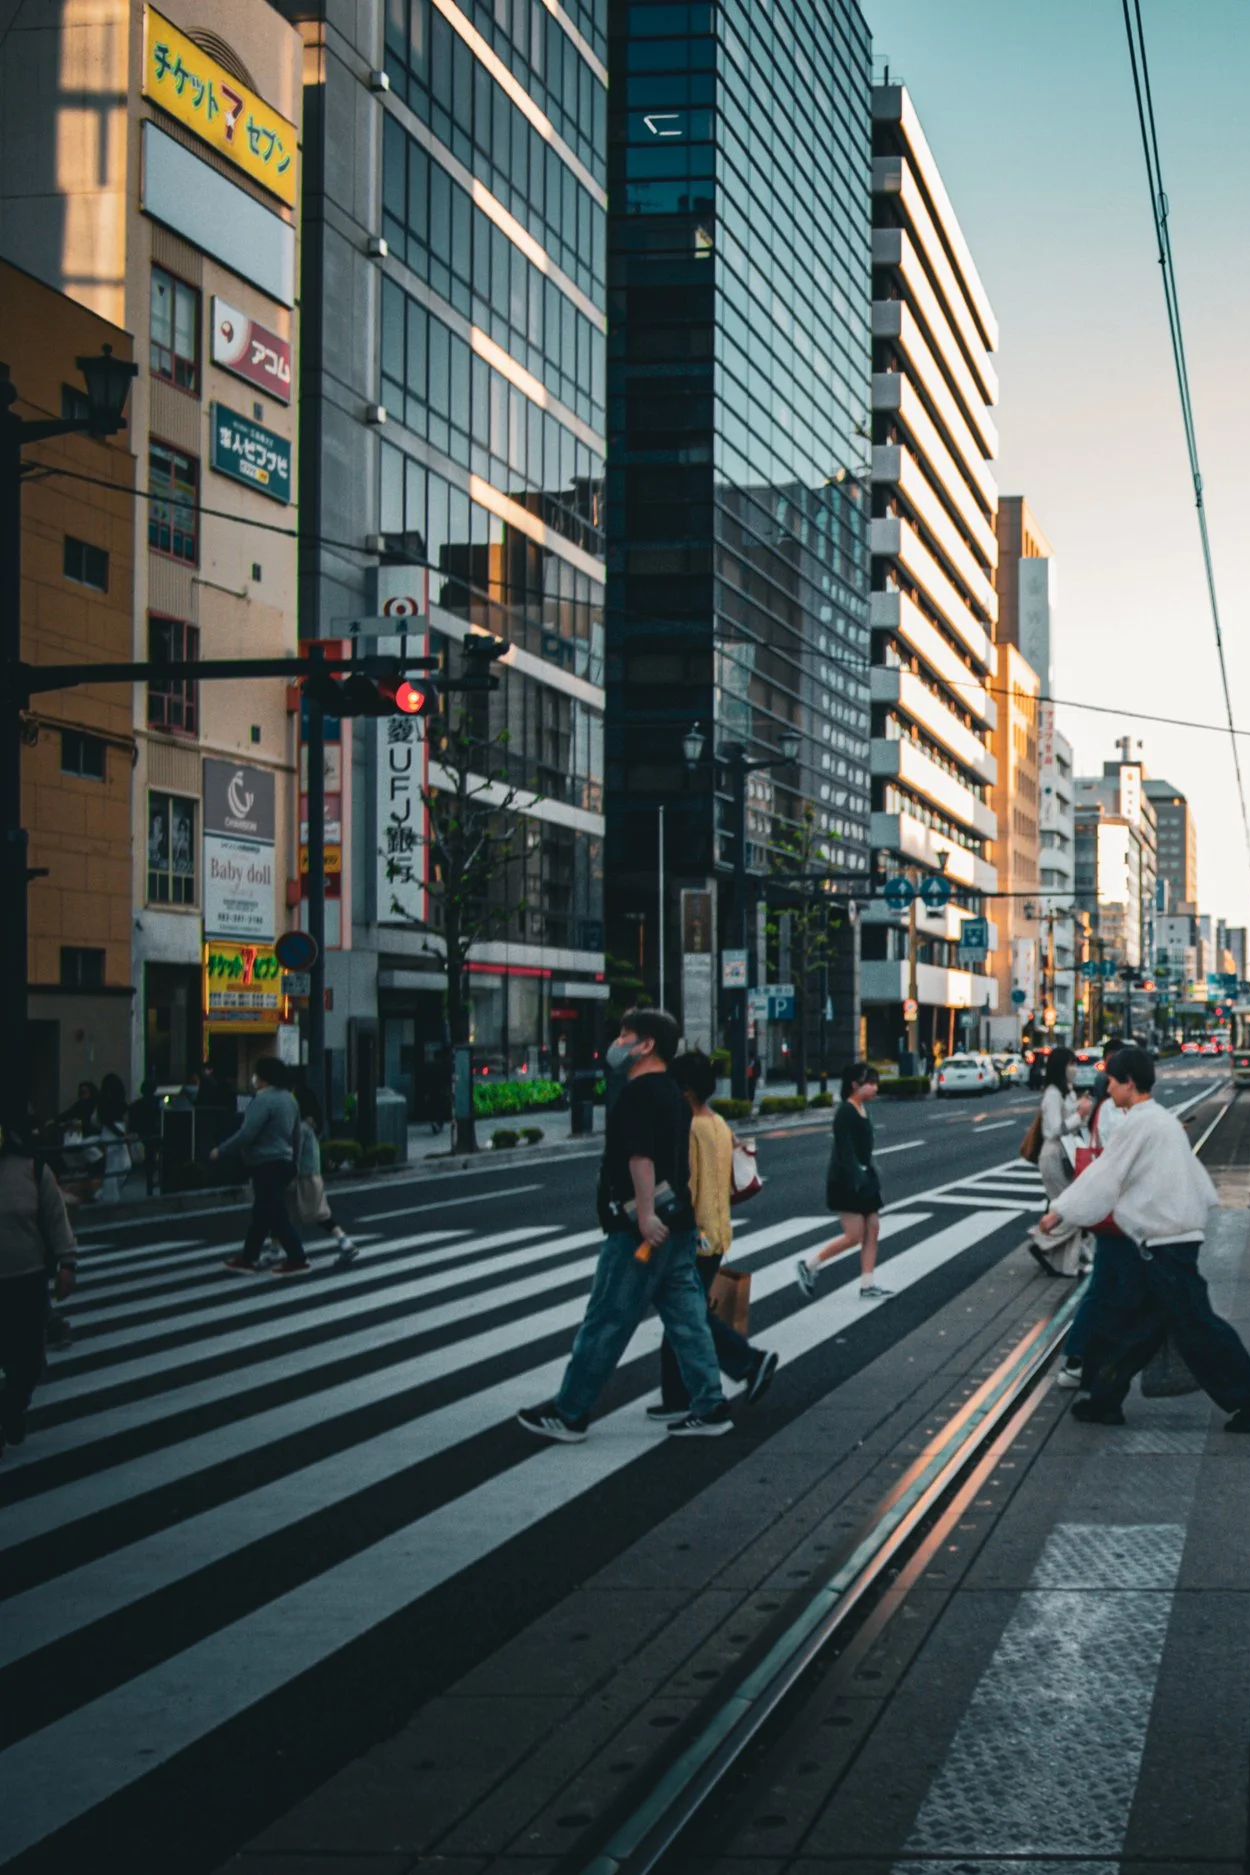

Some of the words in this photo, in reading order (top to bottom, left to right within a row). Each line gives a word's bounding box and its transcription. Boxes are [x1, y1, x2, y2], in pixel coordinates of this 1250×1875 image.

[251, 340, 290, 384] アコム
[386, 716, 415, 885] 菱UFJ銀行
[211, 858, 243, 889] Baby
[246, 861, 272, 886] doll
[775, 999, 788, 1018] P
